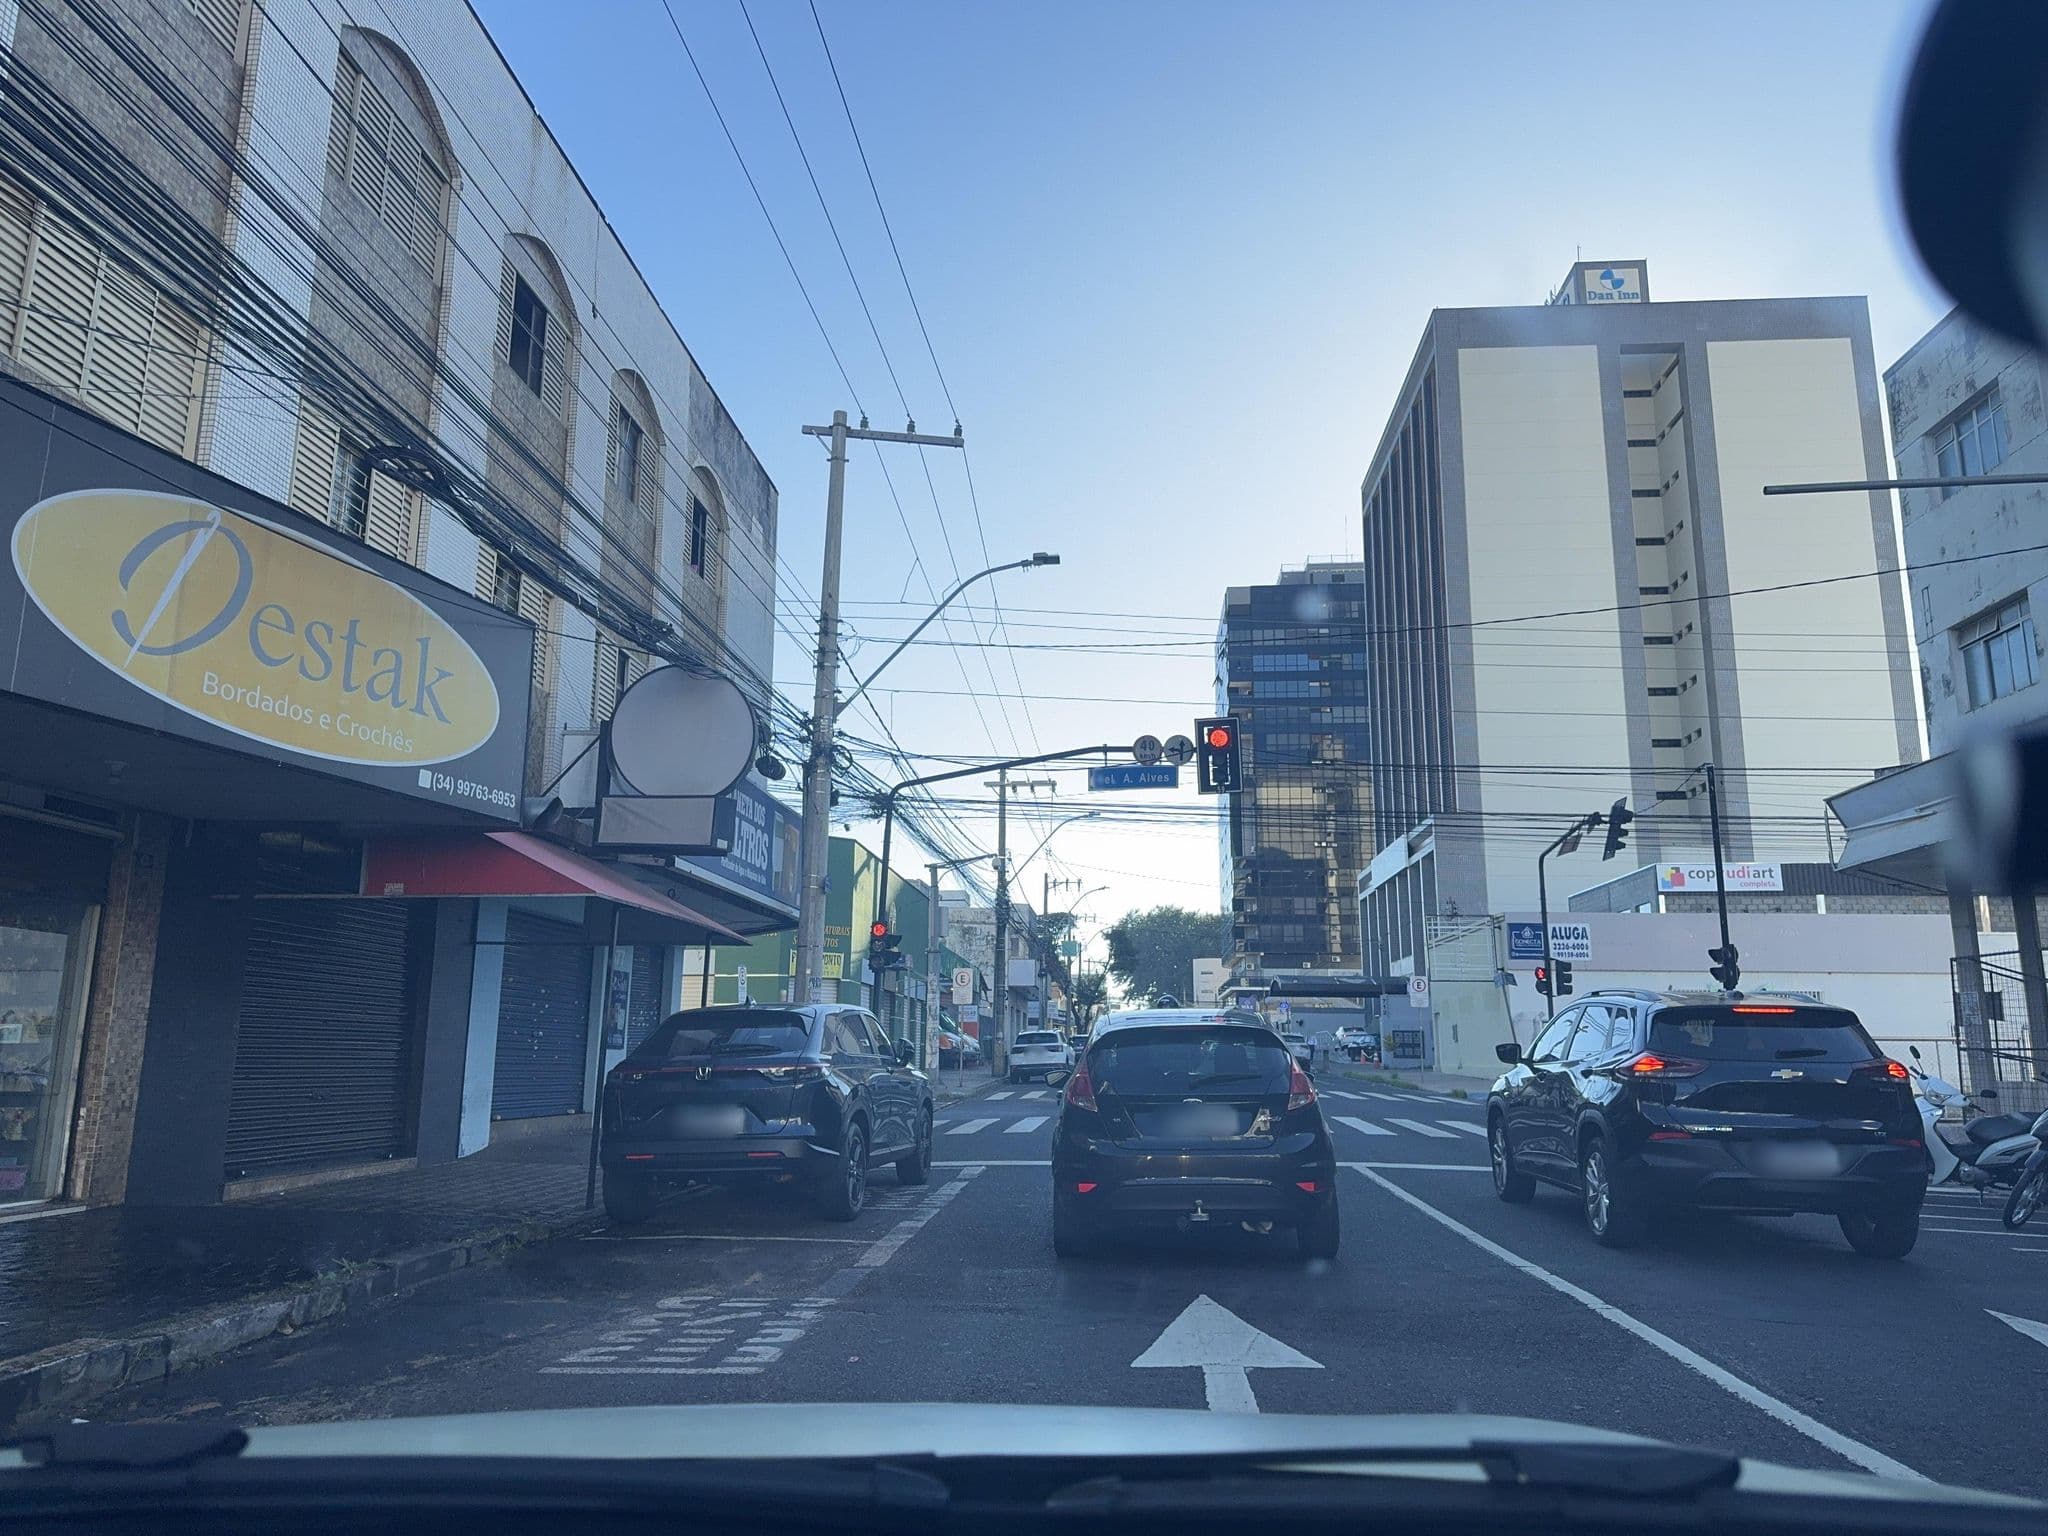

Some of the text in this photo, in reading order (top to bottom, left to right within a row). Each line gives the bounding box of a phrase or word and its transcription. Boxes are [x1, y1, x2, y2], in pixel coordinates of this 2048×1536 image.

[1587, 290, 1640, 301] Dan Inn
[111, 518, 454, 725] Destak
[202, 671, 414, 753] Bordados e Crochês
[1140, 740, 1155, 751] 40
[1123, 773, 1134, 784] A.
[1139, 772, 1170, 784] Alves
[433, 772, 516, 808] (34) 99763-6953
[754, 800, 767, 828] DOS
[1688, 866, 1775, 882] copudiart
[1740, 880, 1776, 889] completa
[823, 925, 851, 936] ATURAIS
[1551, 926, 1590, 941] ALUGA
[960, 974, 966, 984] E
[1416, 981, 1422, 990] E
